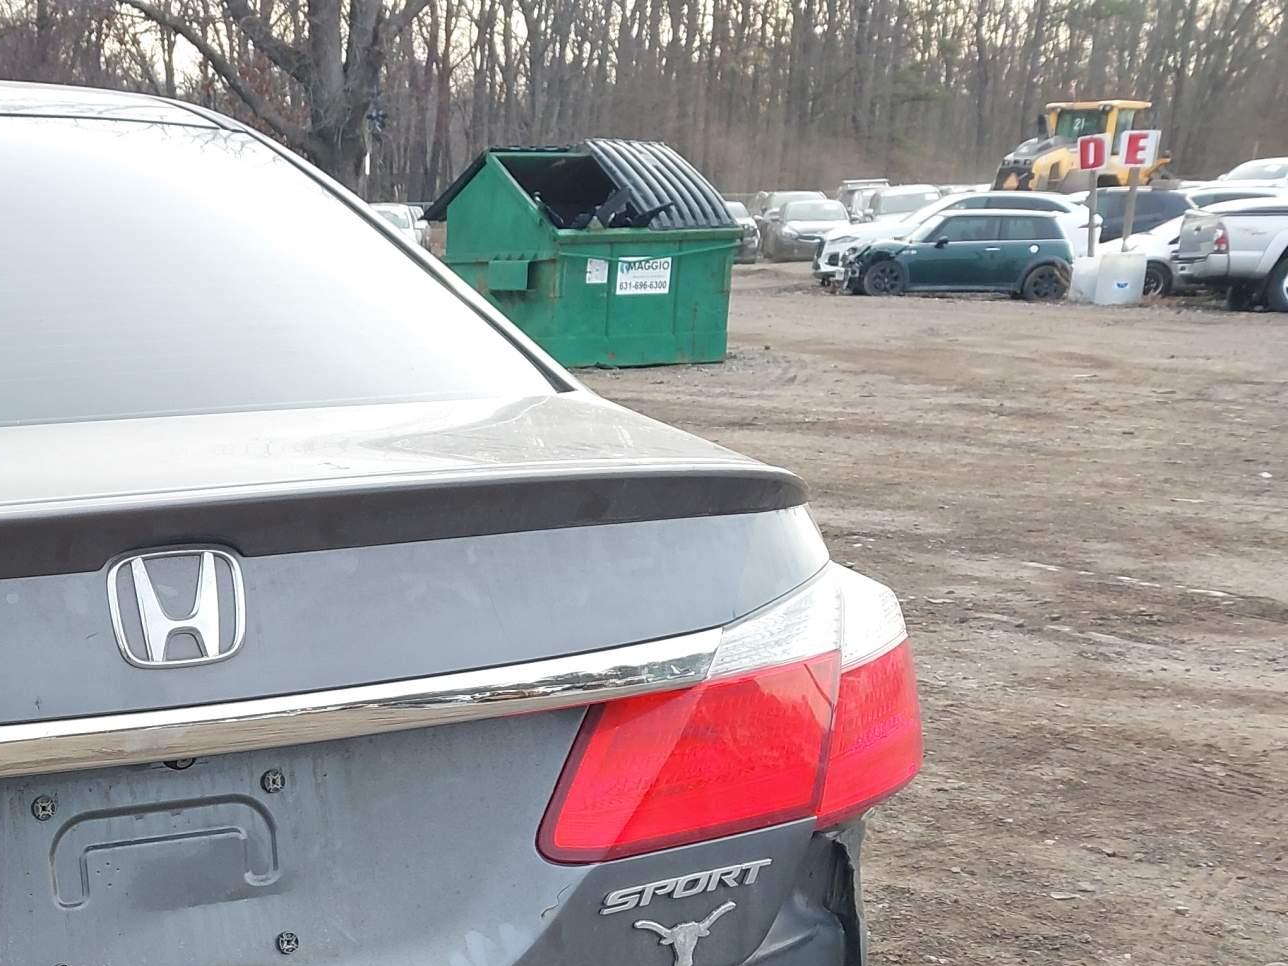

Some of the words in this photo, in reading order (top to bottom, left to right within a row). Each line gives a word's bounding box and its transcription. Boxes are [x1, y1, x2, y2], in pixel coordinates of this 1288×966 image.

[1079, 137, 1106, 169] D
[1124, 133, 1150, 165] E
[630, 260, 670, 271] MAGGIO
[599, 858, 773, 915] SPORT
